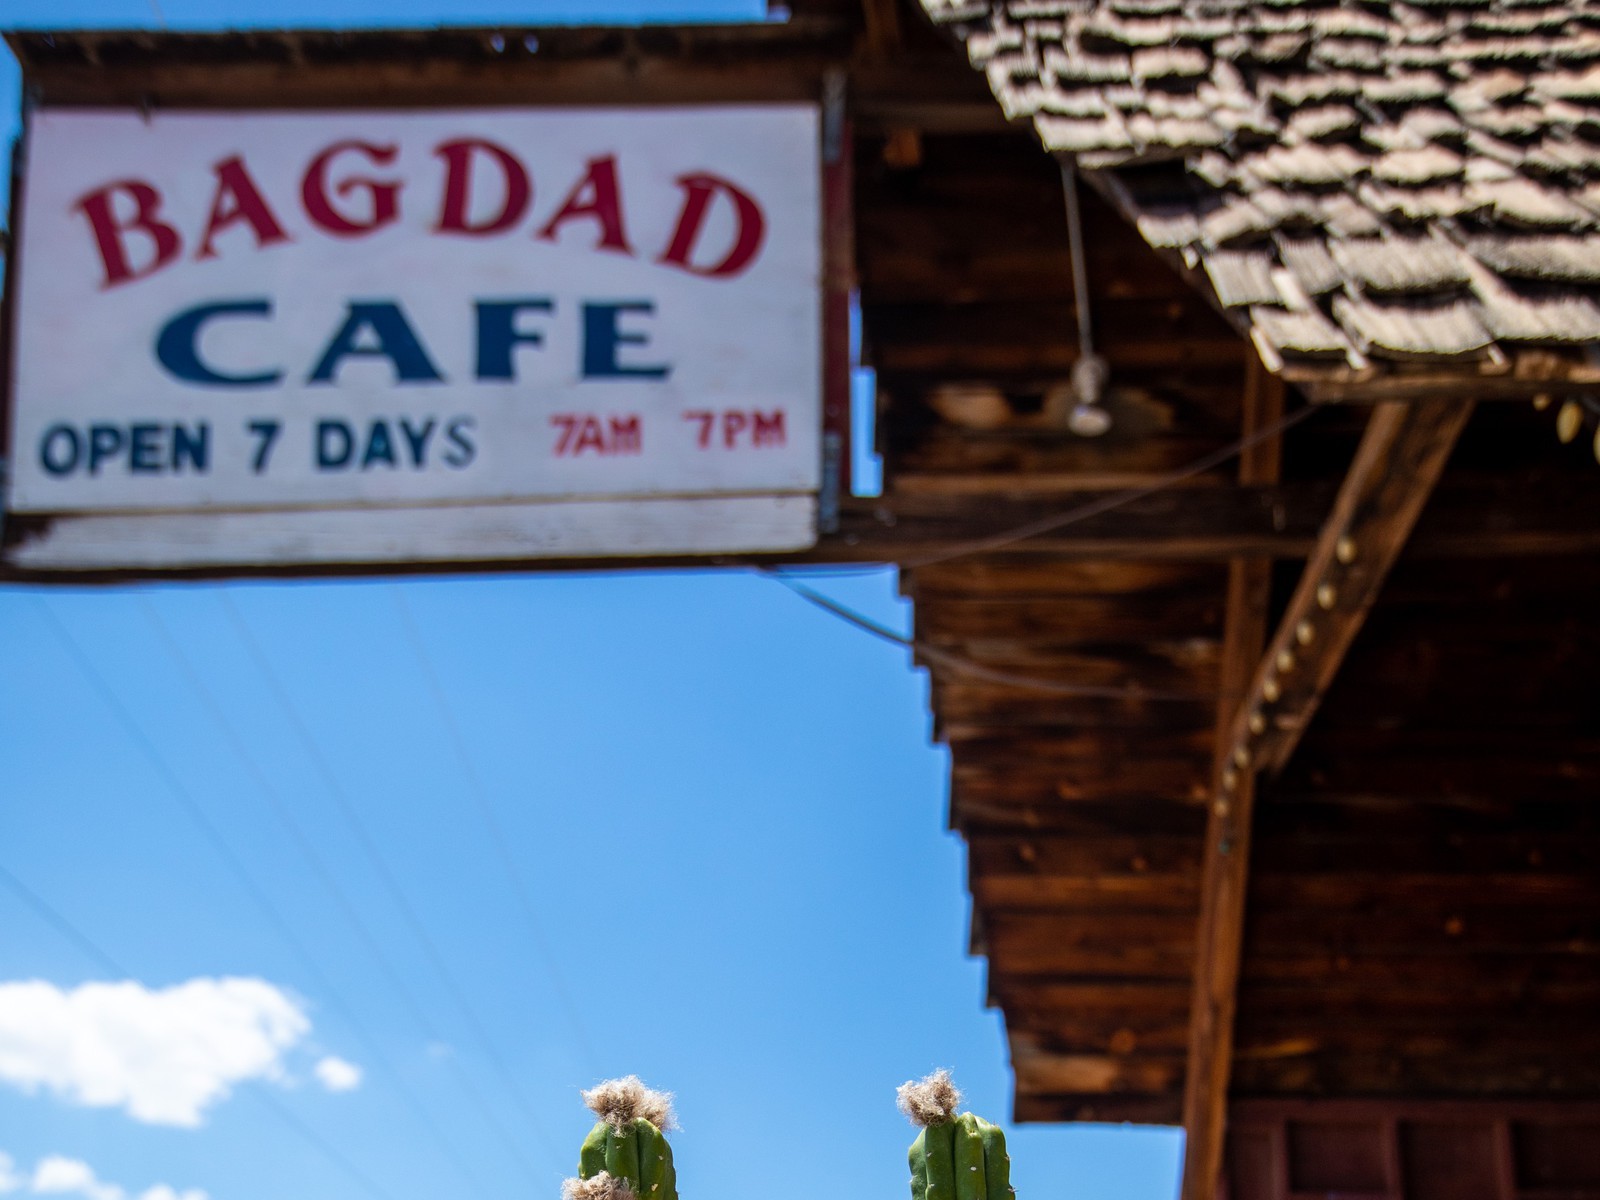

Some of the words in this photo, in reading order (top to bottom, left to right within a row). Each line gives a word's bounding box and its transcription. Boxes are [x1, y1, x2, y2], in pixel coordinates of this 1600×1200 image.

[73, 136, 767, 291] BAGDAD
[153, 296, 672, 390] CAFE
[38, 420, 212, 478] OPEN
[246, 420, 281, 474] 7
[313, 416, 478, 470] DAYS
[550, 413, 643, 456] 7AM
[683, 409, 786, 451] 7PM
